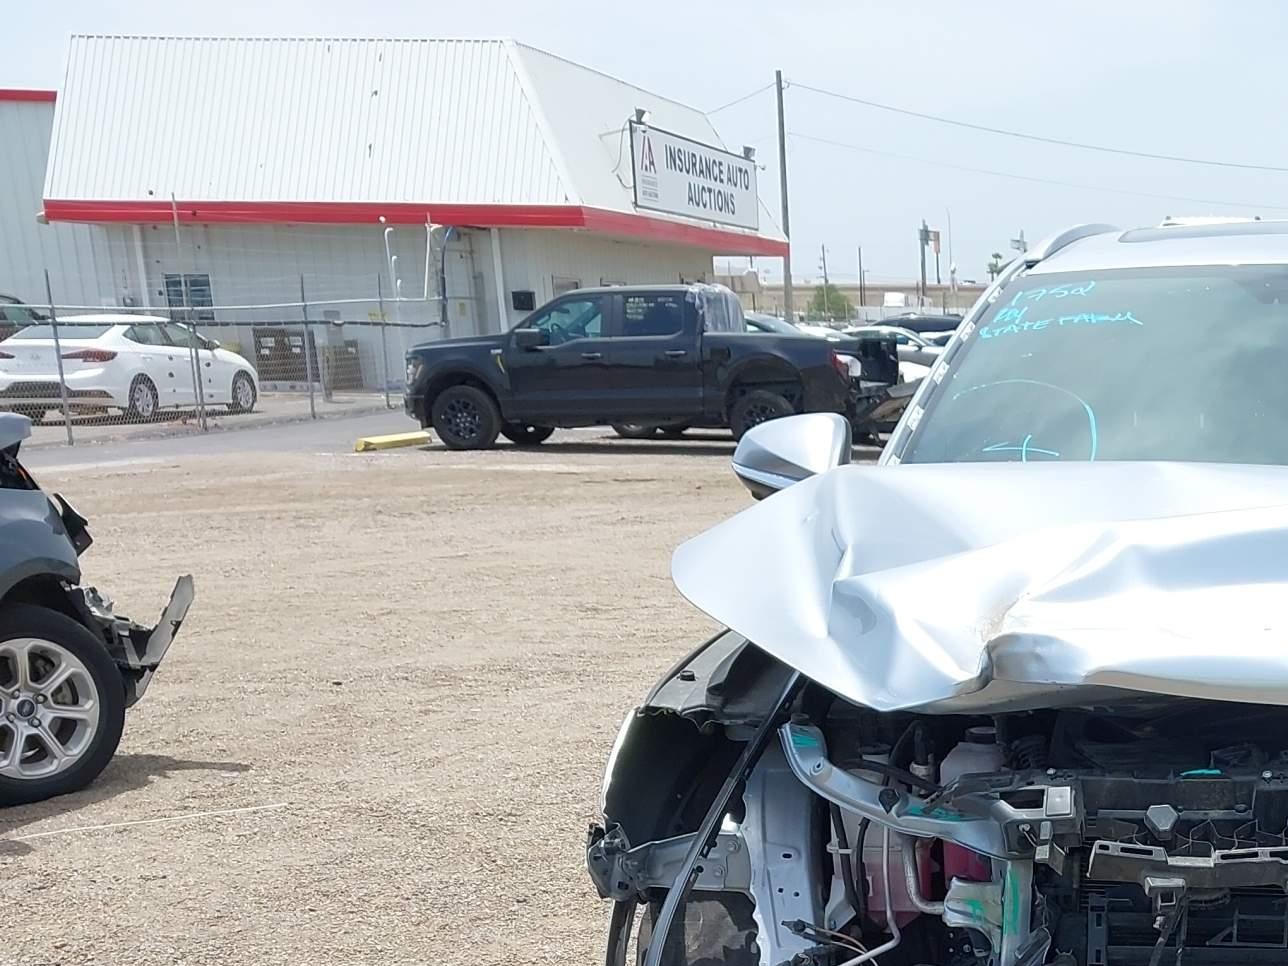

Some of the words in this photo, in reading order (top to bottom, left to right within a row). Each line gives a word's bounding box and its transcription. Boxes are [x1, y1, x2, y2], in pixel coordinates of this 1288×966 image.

[664, 143, 725, 184] INSURANCE
[726, 163, 750, 191] AUTO
[687, 181, 736, 215] AUCTIONS
